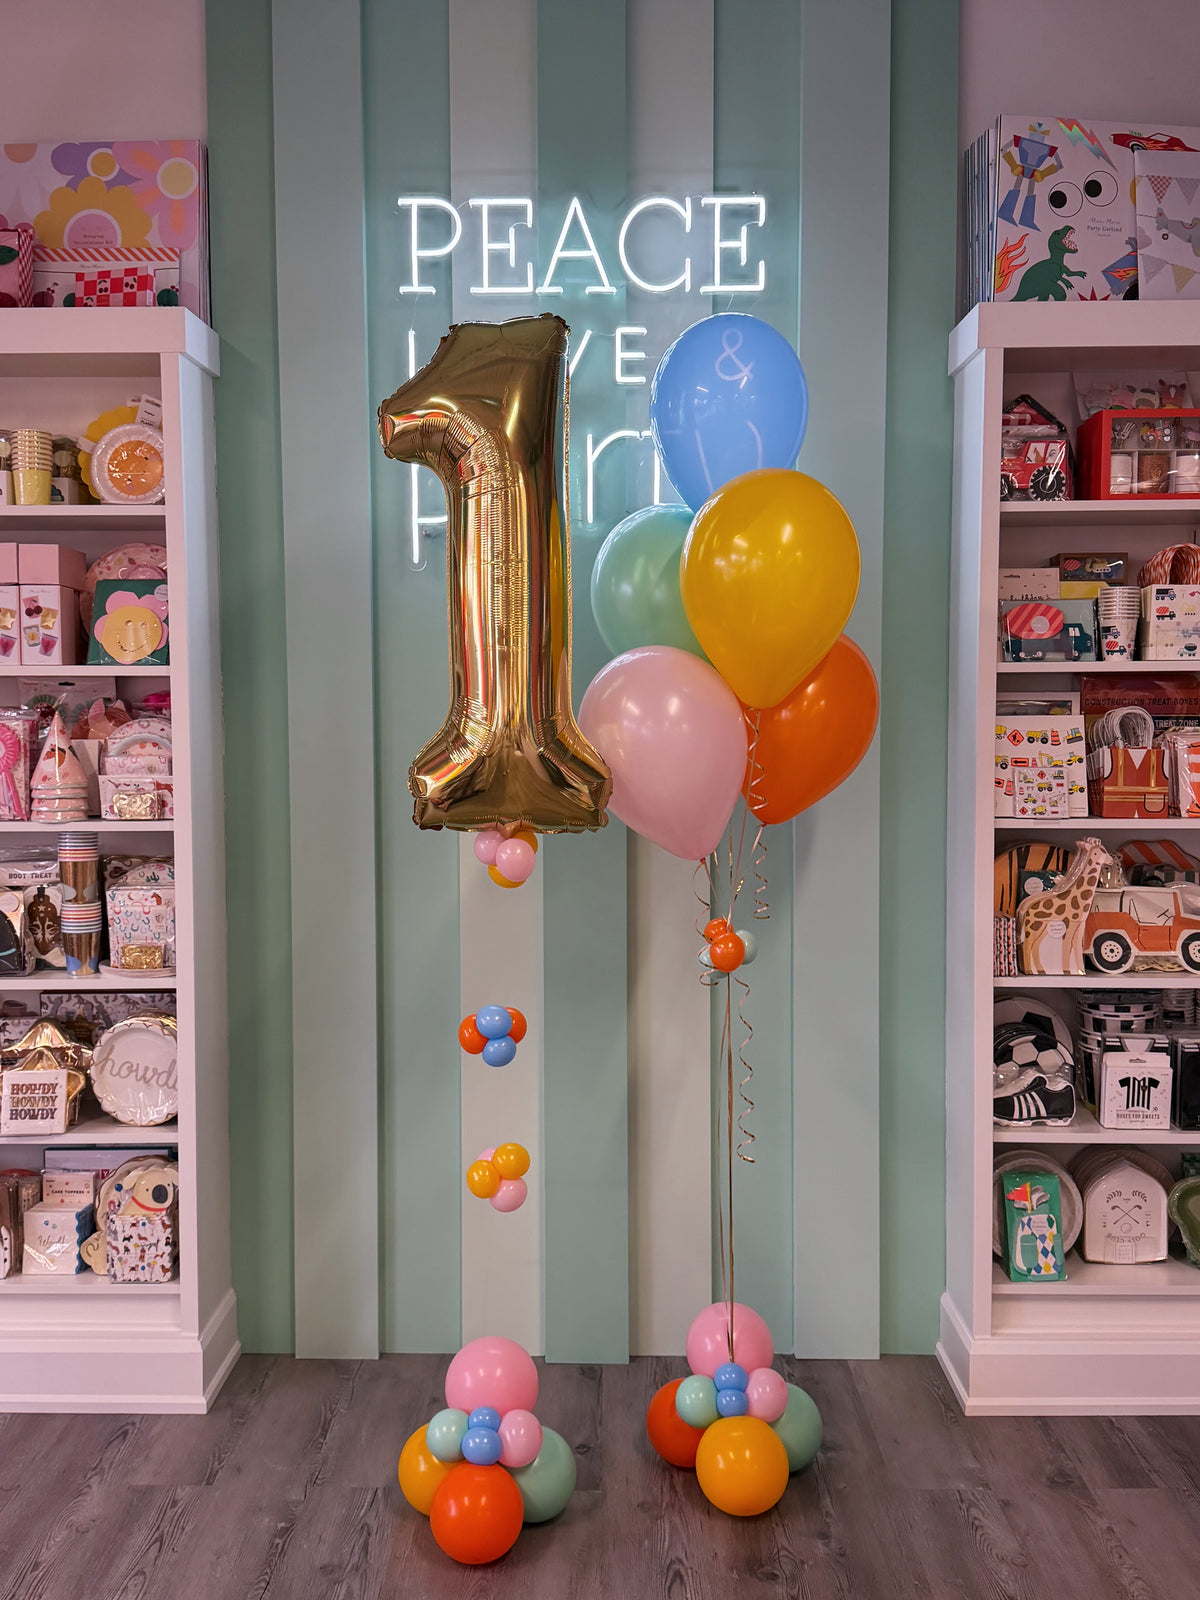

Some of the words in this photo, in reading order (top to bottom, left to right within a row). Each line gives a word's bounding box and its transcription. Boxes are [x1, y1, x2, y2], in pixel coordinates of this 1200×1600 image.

[397, 196, 767, 295] PEACE
[1084, 698, 1145, 706] CONSTRUCTION
[1148, 698, 1170, 706] TREAT
[1173, 697, 1199, 706] BOXES
[1155, 719, 1177, 728] TREAT
[1179, 719, 1199, 728] ZONE
[95, 1043, 178, 1092] howd
[10, 1083, 58, 1095] HOWDY
[10, 1095, 58, 1108] HOWDY
[9, 1107, 58, 1120] HOWDY
